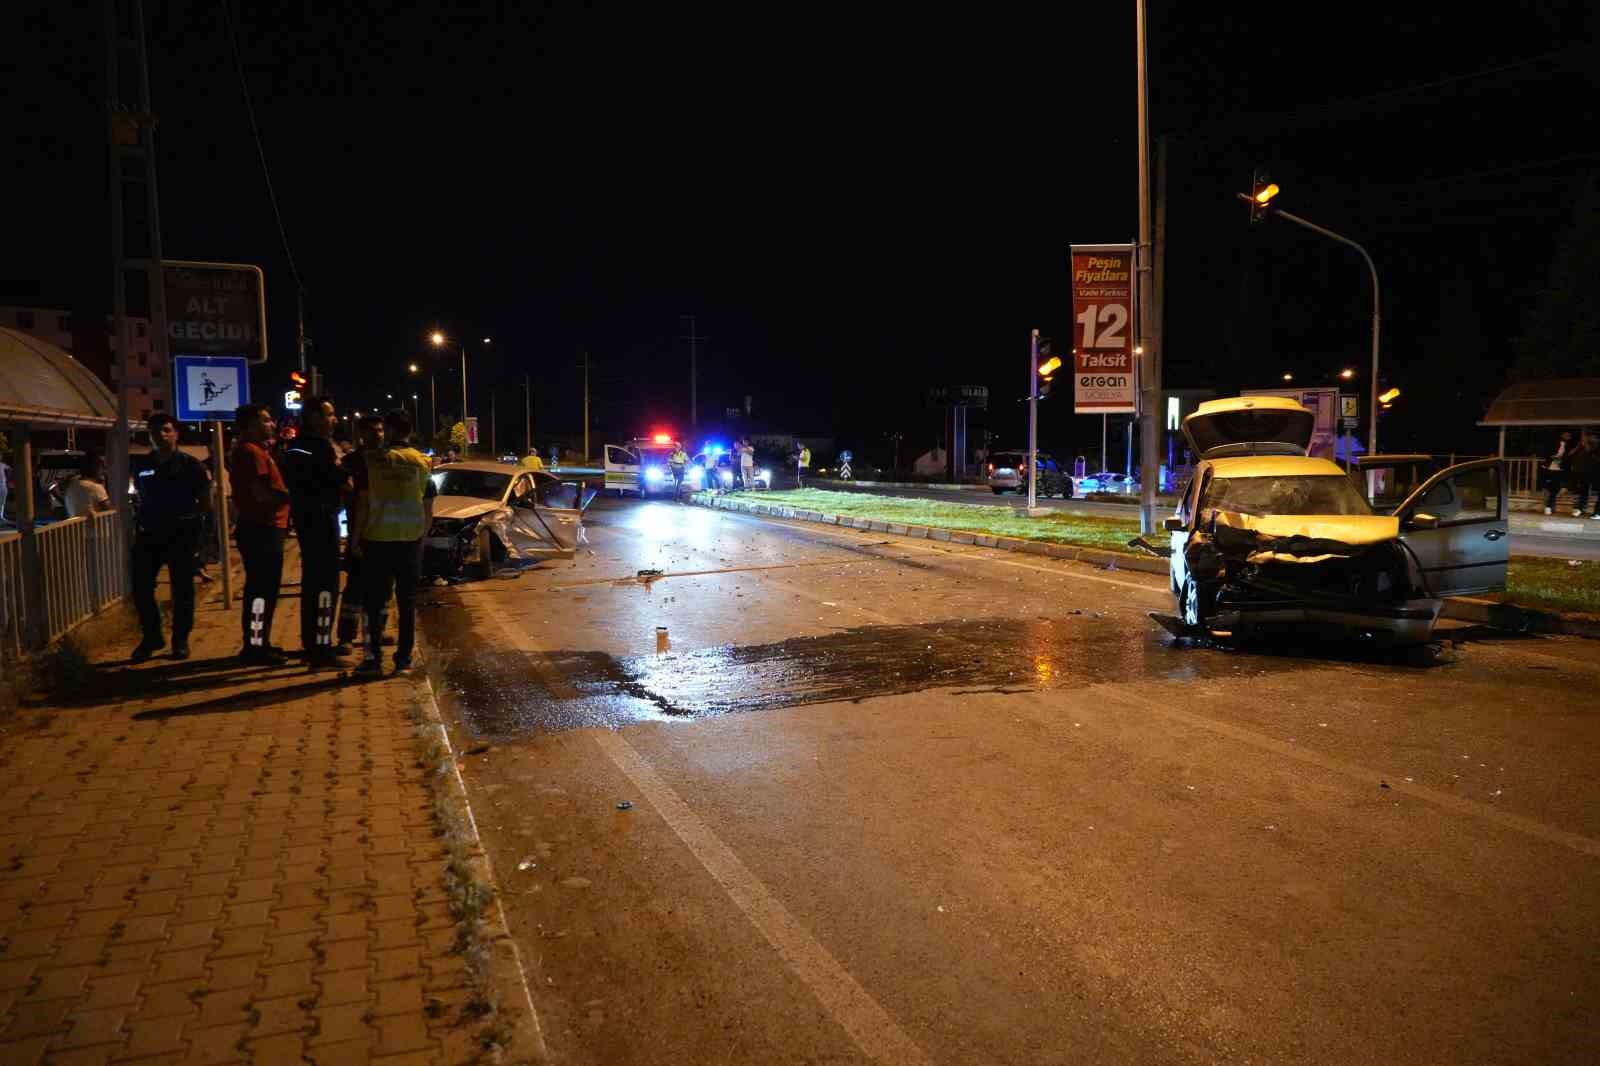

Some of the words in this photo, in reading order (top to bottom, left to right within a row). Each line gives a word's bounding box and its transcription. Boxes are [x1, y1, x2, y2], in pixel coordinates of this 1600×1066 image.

[1088, 256, 1121, 271] Peşin
[1075, 270, 1129, 284] Fiyatlara
[186, 296, 230, 314] ALT
[1077, 304, 1128, 348] 12
[1080, 353, 1127, 367] Taksit
